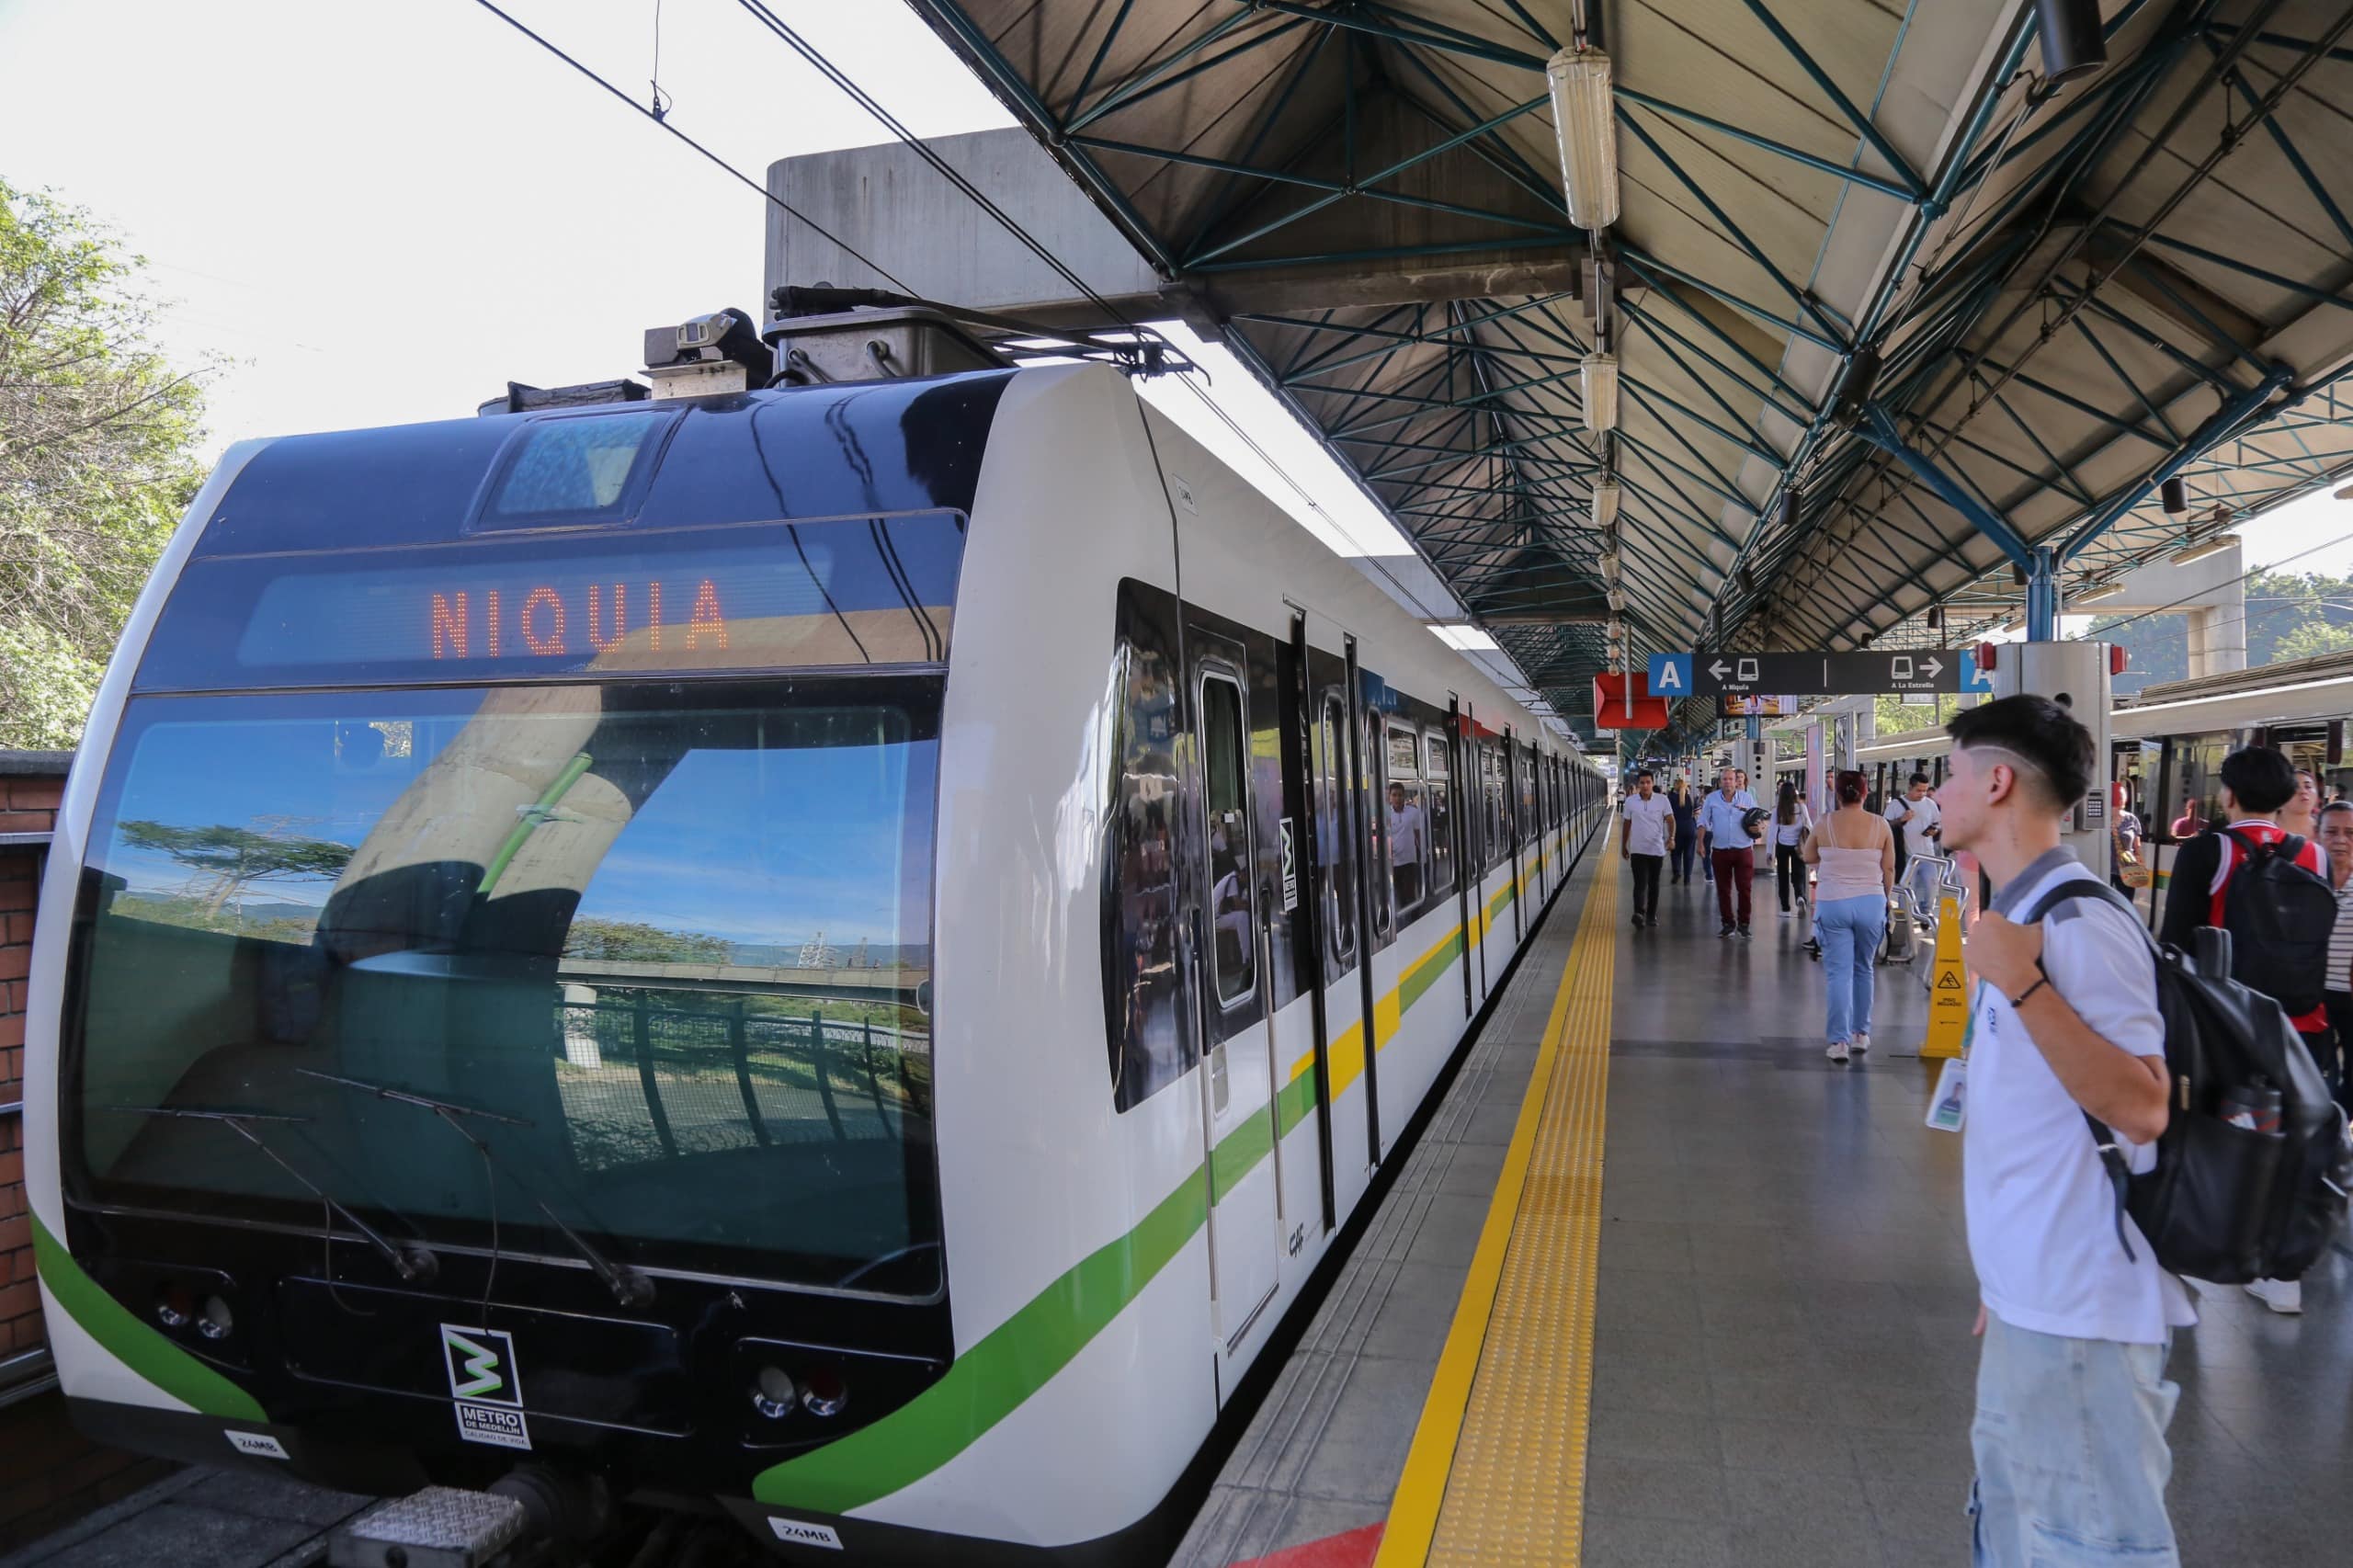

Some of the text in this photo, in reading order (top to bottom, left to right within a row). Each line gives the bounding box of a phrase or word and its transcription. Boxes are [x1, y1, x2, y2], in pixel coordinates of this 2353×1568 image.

[432, 579, 729, 660] NIQUIA
[1658, 661, 1682, 688] A
[462, 1406, 518, 1427] METRO
[465, 1419, 477, 1428] DE
[782, 1526, 832, 1542] 24MB
